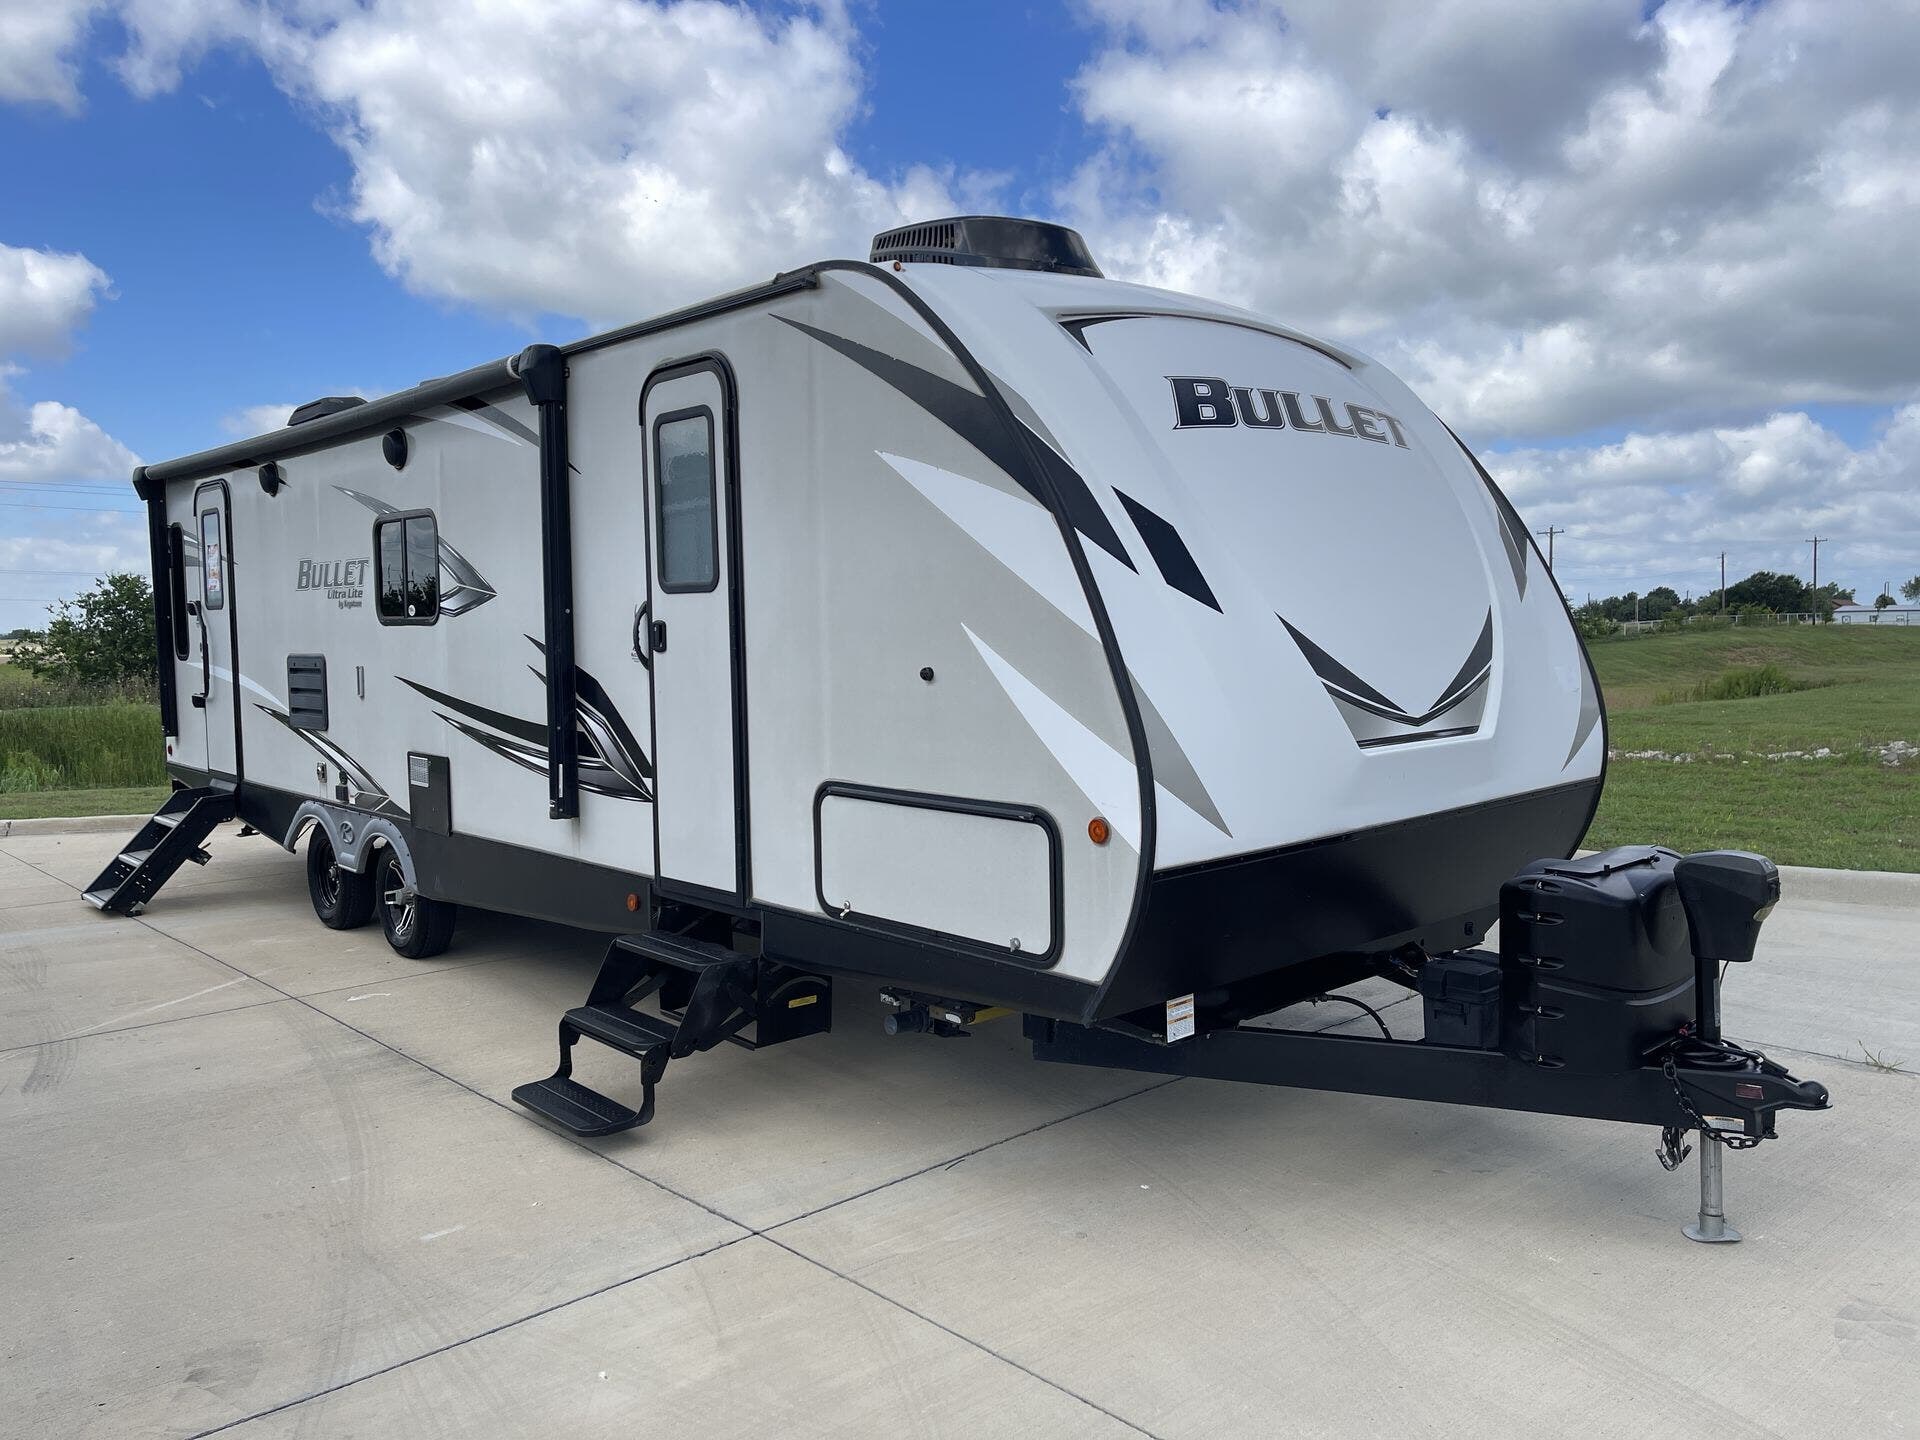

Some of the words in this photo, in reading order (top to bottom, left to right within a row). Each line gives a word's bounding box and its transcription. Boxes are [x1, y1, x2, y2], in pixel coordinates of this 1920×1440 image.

[1163, 375, 1412, 450] BULLET
[296, 557, 370, 591] BULLET
[327, 590, 346, 600] Ultra
[348, 588, 363, 598] Lite
